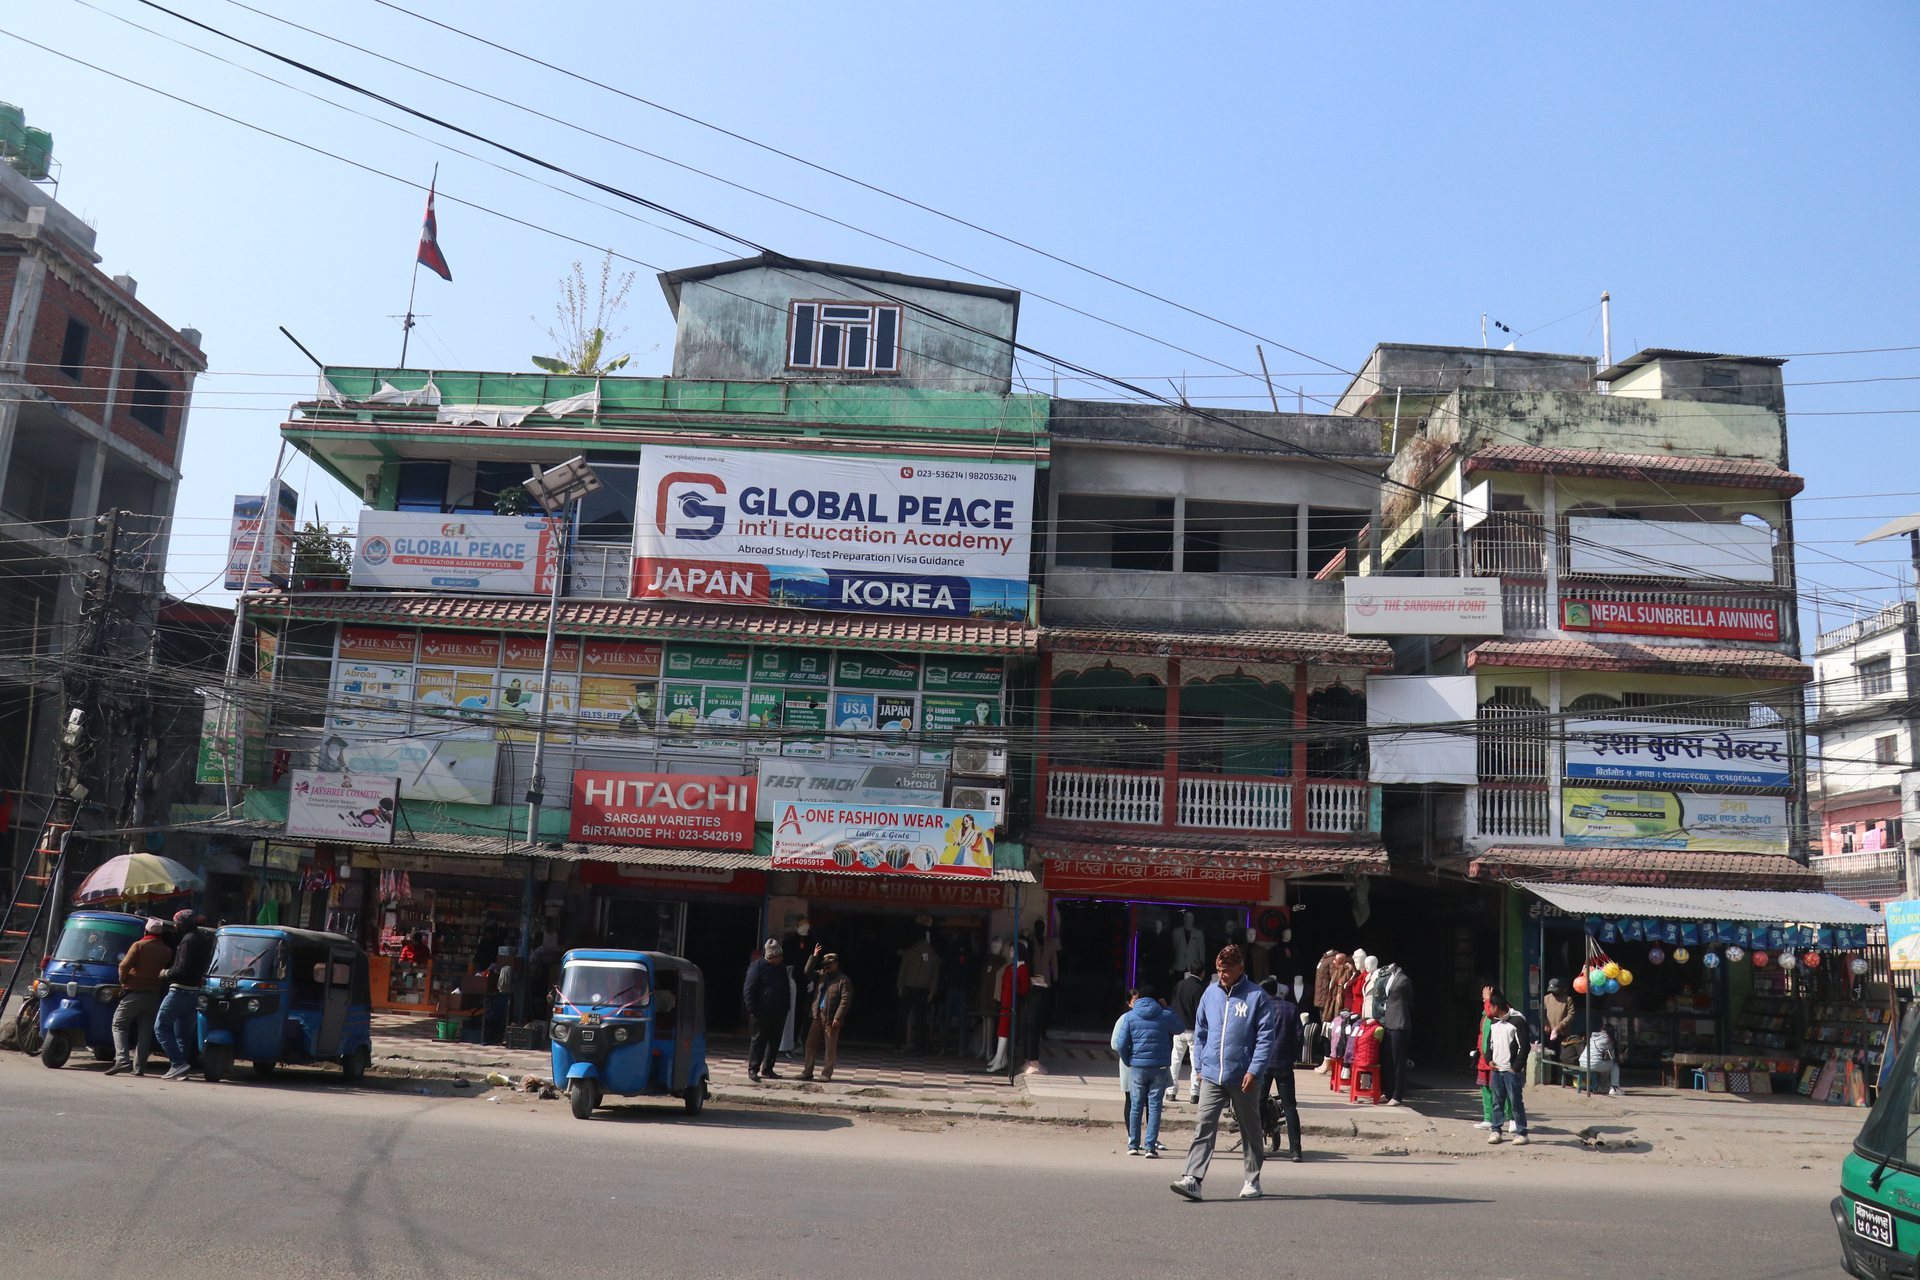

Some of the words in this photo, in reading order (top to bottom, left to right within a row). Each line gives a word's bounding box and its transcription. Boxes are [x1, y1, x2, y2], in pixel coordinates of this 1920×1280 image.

[916, 469, 964, 480] 023-536214
[968, 472, 1017, 482] 9820536214
[739, 486, 888, 523] GLOBAL
[897, 494, 1015, 530] PEACE
[784, 521, 897, 545] Education
[903, 528, 1013, 556] Academy
[394, 538, 463, 557] GLOBAL
[468, 541, 526, 559] PEACE
[738, 544, 774, 555] Abroad
[775, 546, 805, 559] Study
[811, 549, 831, 560] Test
[833, 550, 891, 563] Preparation
[896, 555, 917, 564] Visa
[919, 556, 965, 567] Guidance
[647, 566, 754, 597] JAPAN
[841, 579, 956, 610] KOREA
[1384, 599, 1401, 612] THE
[1403, 600, 1456, 612] SANDWICH
[1457, 600, 1488, 612] POINT
[1592, 604, 1635, 623] NEPAL
[1638, 606, 1715, 627] SUNBRELLA
[1719, 610, 1774, 630] AWNING
[357, 638, 379, 648] THE
[382, 639, 414, 650] NEXT
[441, 643, 461, 653] THE
[466, 645, 494, 655] NEXT
[521, 648, 543, 658] THE
[549, 649, 576, 660] EXT
[601, 653, 625, 662] THE
[627, 653, 660, 664] NEXT
[694, 657, 716, 665] FAST
[717, 658, 745, 667] TRACK
[344, 668, 377, 680] Abroad
[864, 667, 886, 675] FAST
[888, 669, 915, 677] TRACK
[950, 671, 973, 679] FAST
[975, 673, 1001, 681] TRACK
[420, 675, 453, 686] CANADA
[524, 679, 569, 693] Caada
[673, 694, 694, 706] UK
[751, 693, 776, 705] JAPAN
[842, 702, 868, 715] USA
[880, 704, 911, 717] JAPAN
[934, 707, 956, 715] English
[764, 775, 802, 789] FAST
[806, 776, 857, 791] TRACK
[911, 771, 936, 783] Study
[310, 786, 345, 796] JAYSHREE
[346, 789, 383, 799] COSMETIC
[584, 778, 748, 812] HITACHI
[604, 812, 656, 825] SARGAM
[660, 815, 721, 827] VARIETIES
[777, 804, 835, 835] A-ONE
[838, 809, 899, 826] FASHION
[903, 813, 944, 829] WEAR
[582, 825, 652, 838] BIRTAMODE
[655, 828, 675, 839] PH:
[679, 829, 743, 842] 023-542619
[856, 829, 880, 838] Ladies
[888, 831, 910, 840] Gents
[937, 886, 1001, 904] WEAR
